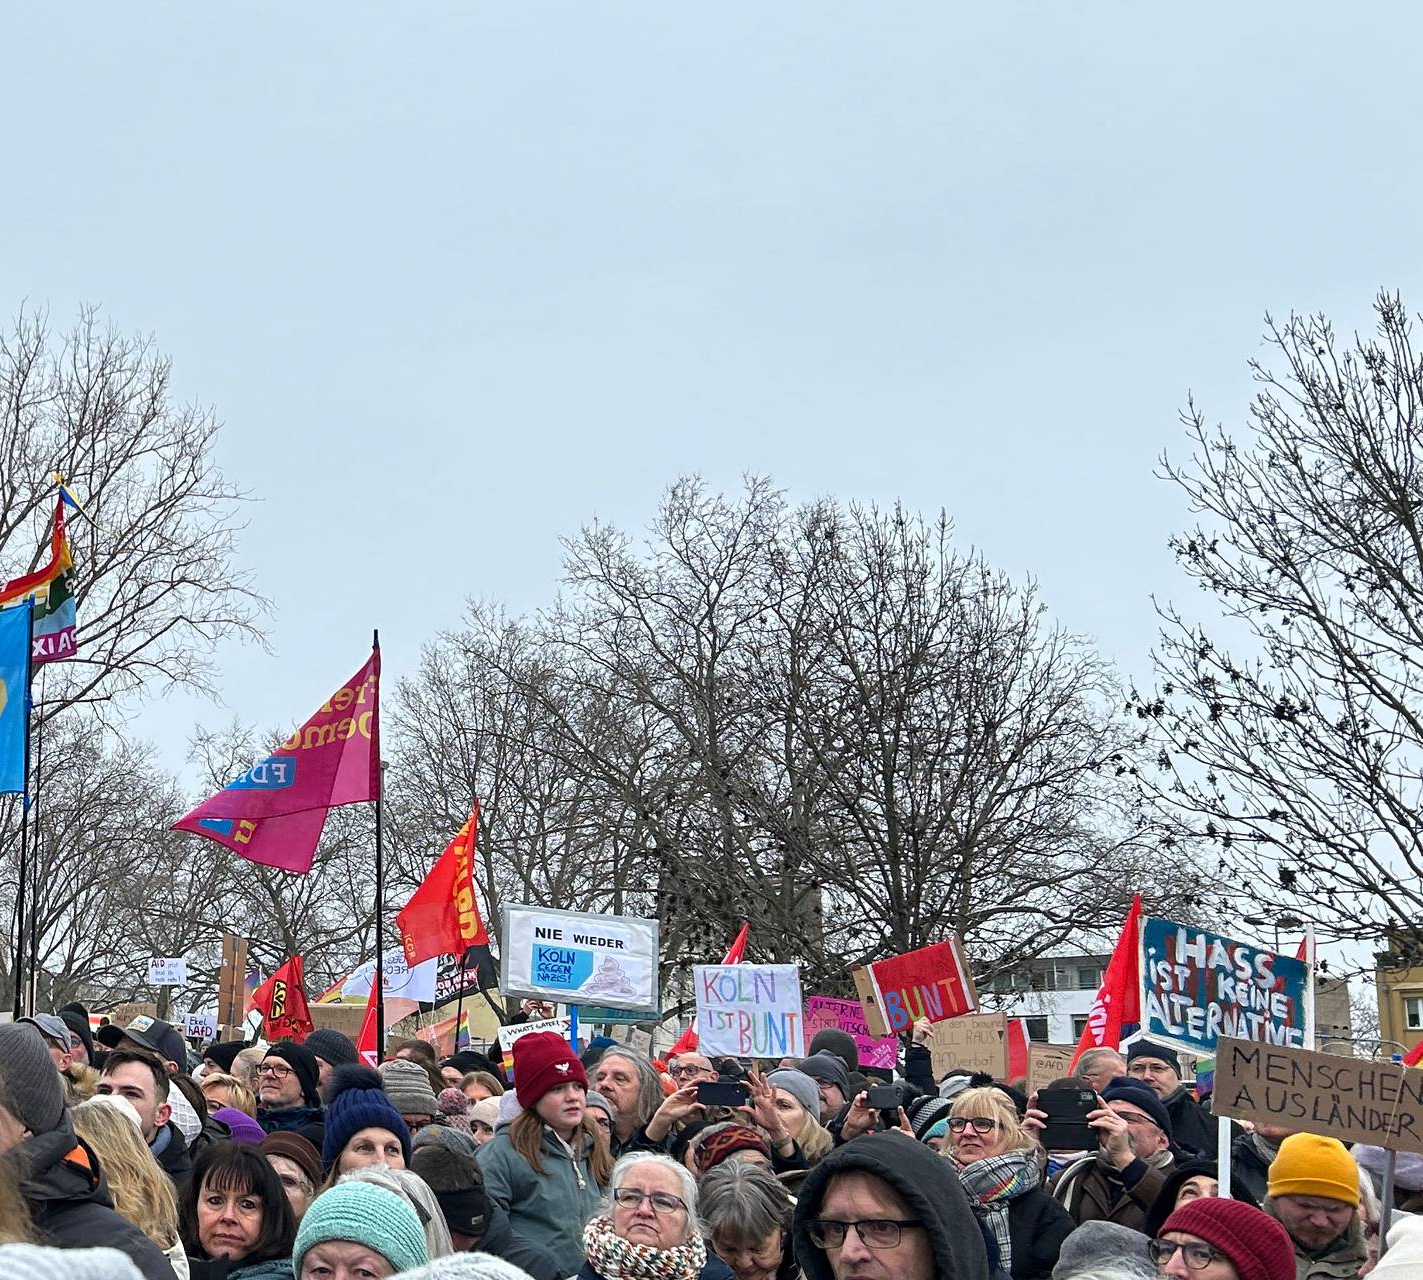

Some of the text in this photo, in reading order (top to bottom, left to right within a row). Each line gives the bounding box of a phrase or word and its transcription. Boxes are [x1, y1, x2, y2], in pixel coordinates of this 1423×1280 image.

[535, 927, 624, 949] NIE WIEDER
[1176, 928, 1275, 990] HASS
[537, 963, 572, 974] GEGEN
[703, 968, 776, 1004] KÖLN
[885, 977, 957, 1029] BUNT
[709, 1010, 733, 1030] IST
[738, 1009, 798, 1055] BUNT
[1232, 1046, 1423, 1106] MENSCHEN
[1232, 1084, 1422, 1142] AUSLÄNDER
